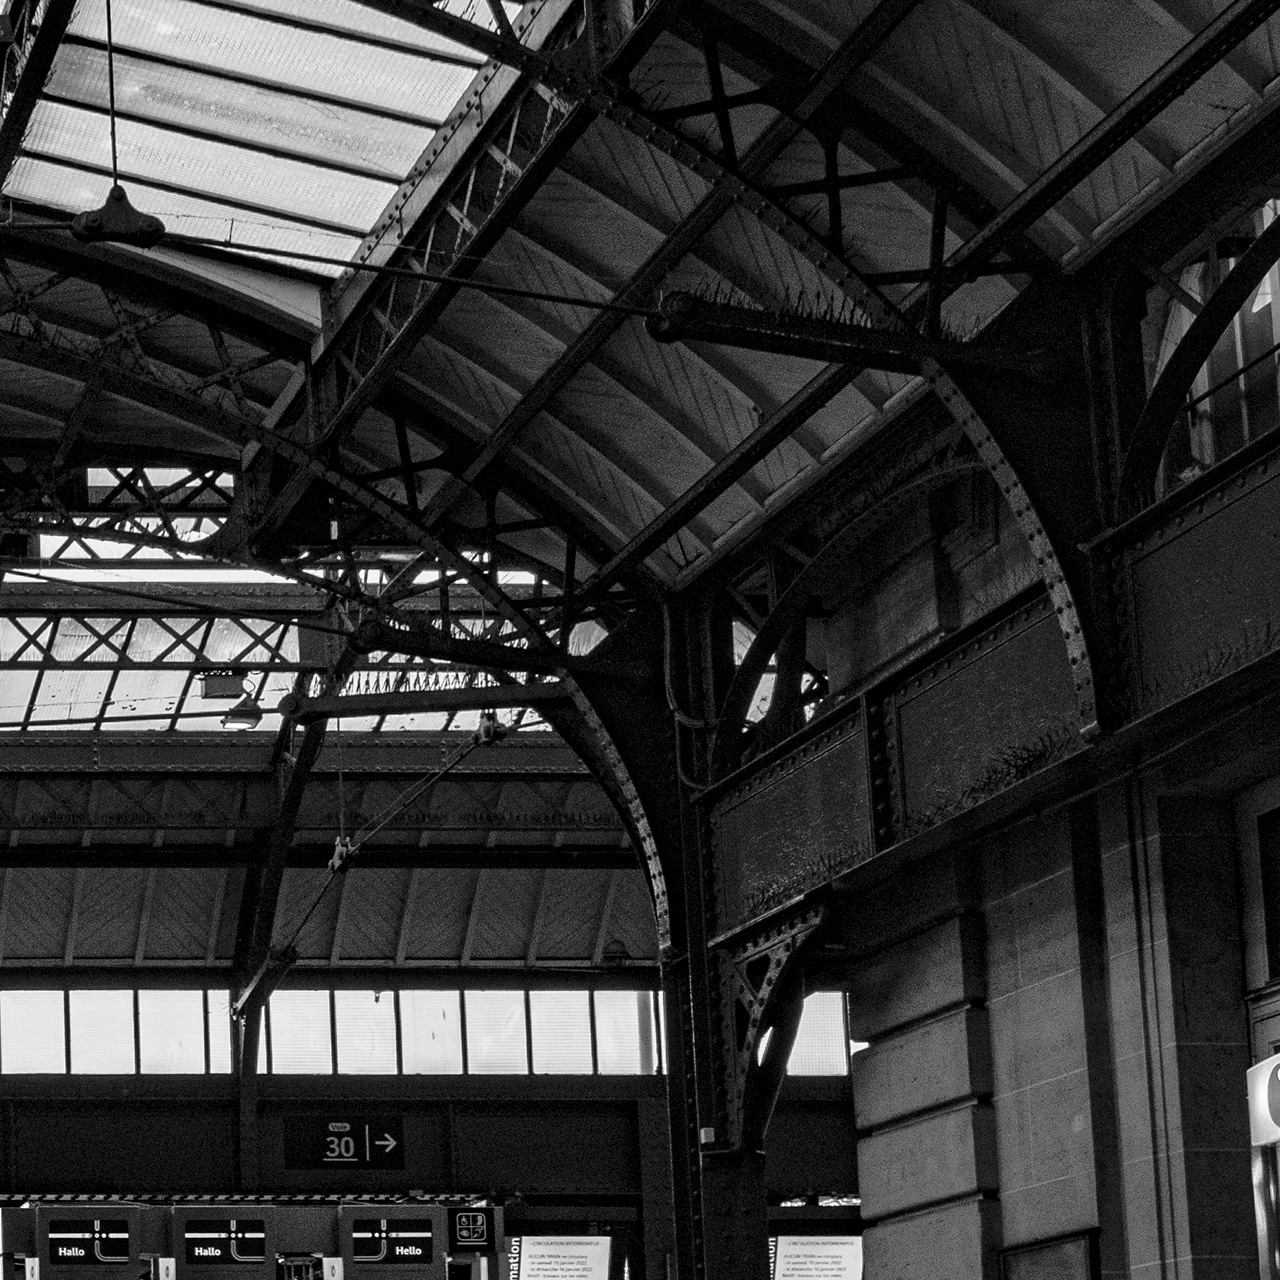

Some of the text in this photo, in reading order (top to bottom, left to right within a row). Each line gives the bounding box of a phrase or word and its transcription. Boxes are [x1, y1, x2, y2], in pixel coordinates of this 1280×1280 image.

[326, 1136, 355, 1157] 30
[58, 1247, 85, 1257] Hallo
[195, 1247, 221, 1257] Hallo
[396, 1245, 422, 1256] Hello
